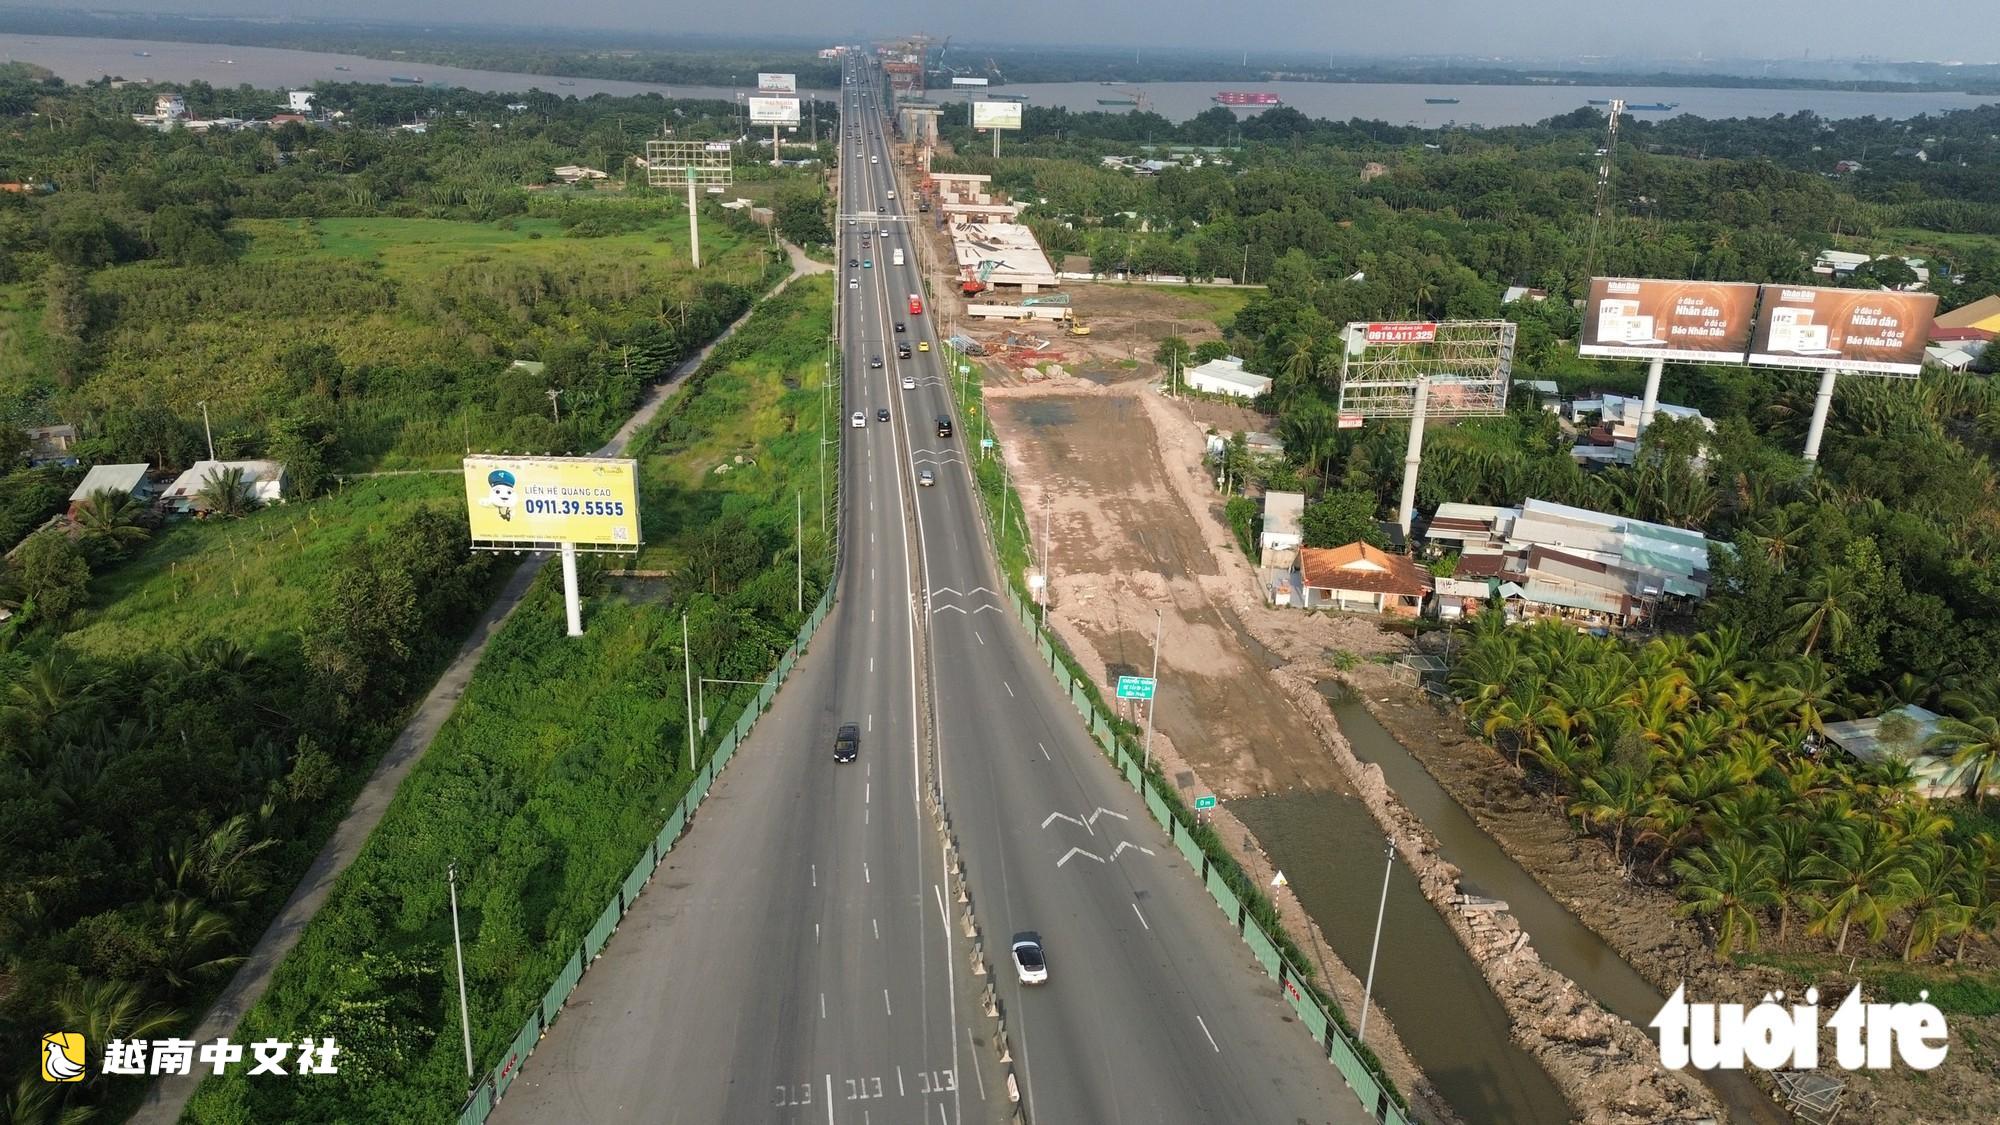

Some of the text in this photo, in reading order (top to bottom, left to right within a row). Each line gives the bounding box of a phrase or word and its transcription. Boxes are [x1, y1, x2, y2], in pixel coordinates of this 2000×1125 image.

[1675, 305, 1720, 317] Nhân dân
[1851, 315, 1898, 327] Nhân dân
[1368, 331, 1434, 340] 0919.411.325
[1671, 325, 1725, 337] Báo Nhân Dân
[1846, 335, 1903, 348] Báo Nhân Dân
[525, 499, 624, 516] 0911.39.5555
